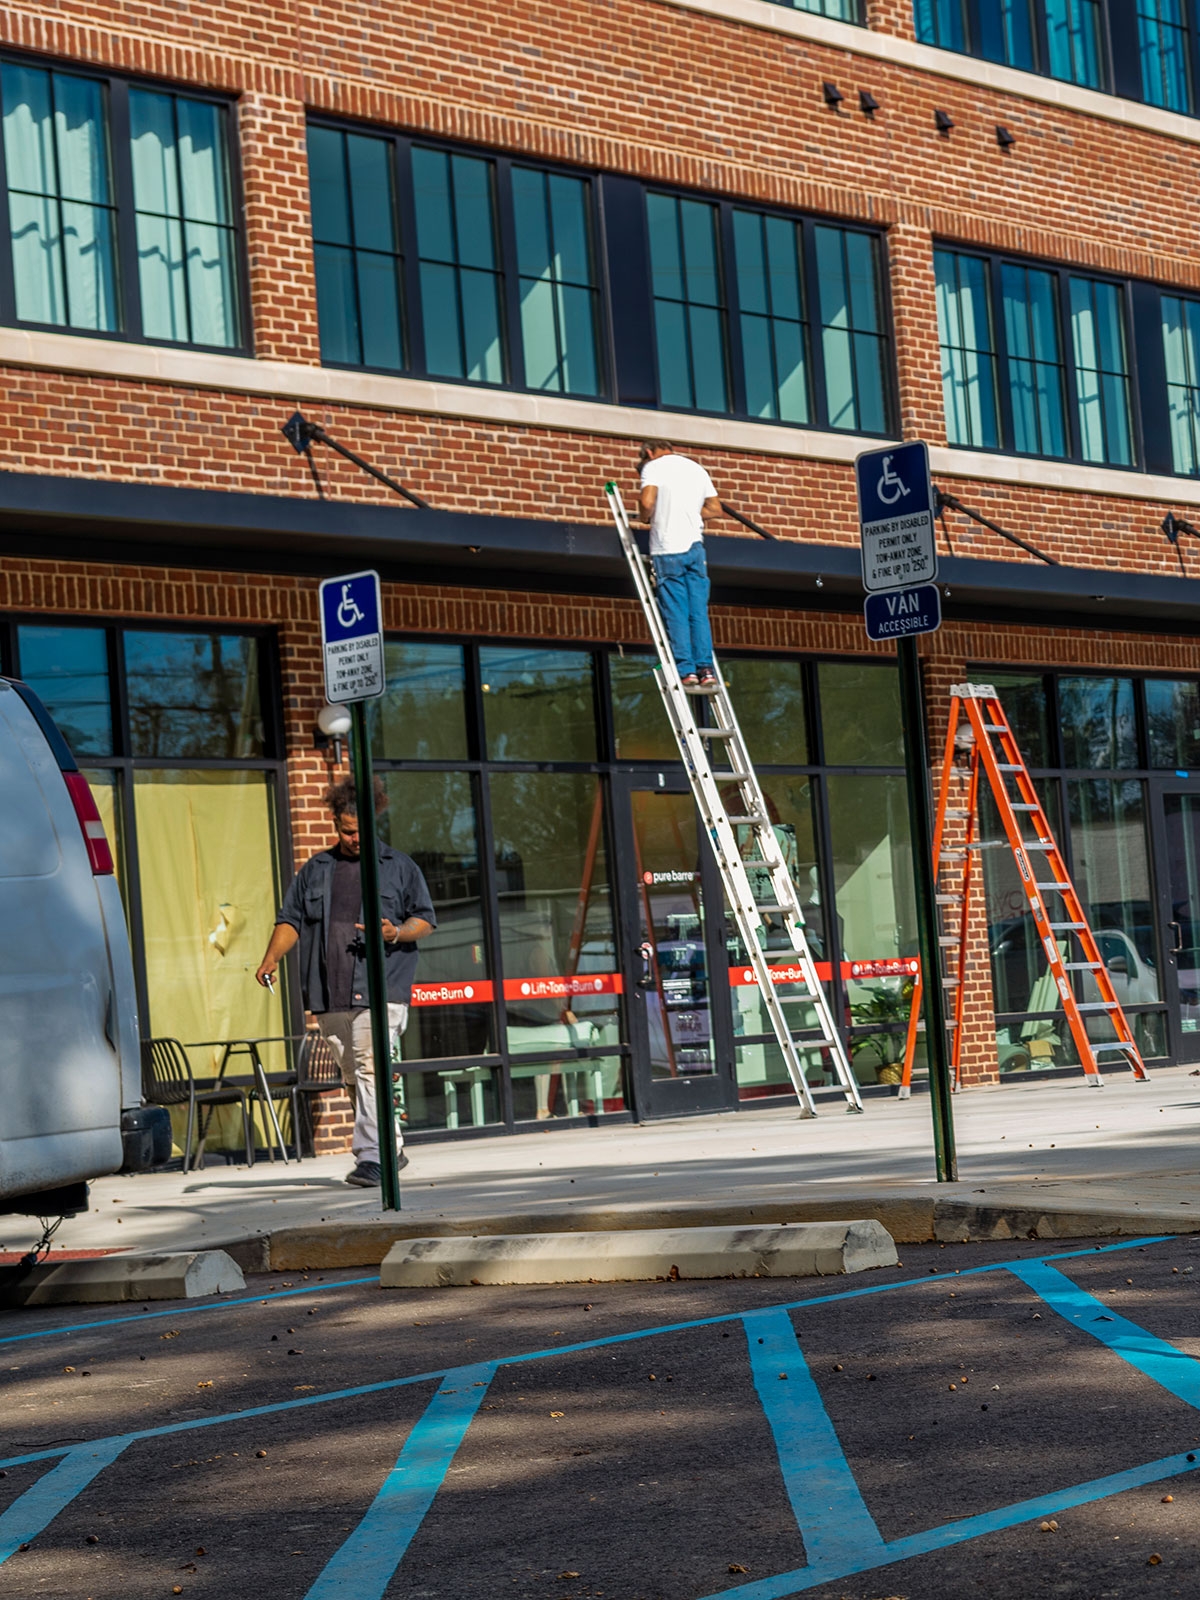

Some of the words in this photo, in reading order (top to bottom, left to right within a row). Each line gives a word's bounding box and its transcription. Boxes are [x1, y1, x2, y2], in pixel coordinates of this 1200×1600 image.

[865, 523, 890, 536] PARKING
[891, 521, 899, 532] BY
[900, 515, 929, 530] DISABLED
[878, 535, 900, 548] PERMIT
[901, 532, 917, 544] ONLY
[876, 549, 906, 564] TOW-AWAY
[907, 545, 922, 558] ZONE
[878, 566, 892, 578] FINE
[893, 564, 902, 575] UP
[902, 563, 910, 574] TO
[886, 592, 920, 616] VAN
[878, 614, 929, 634] ACCESSIBLE
[328, 643, 348, 655] PARKING
[349, 642, 355, 651] BY
[355, 637, 378, 650] DISABLED
[653, 872, 671, 884] pure
[671, 870, 694, 881] barre
